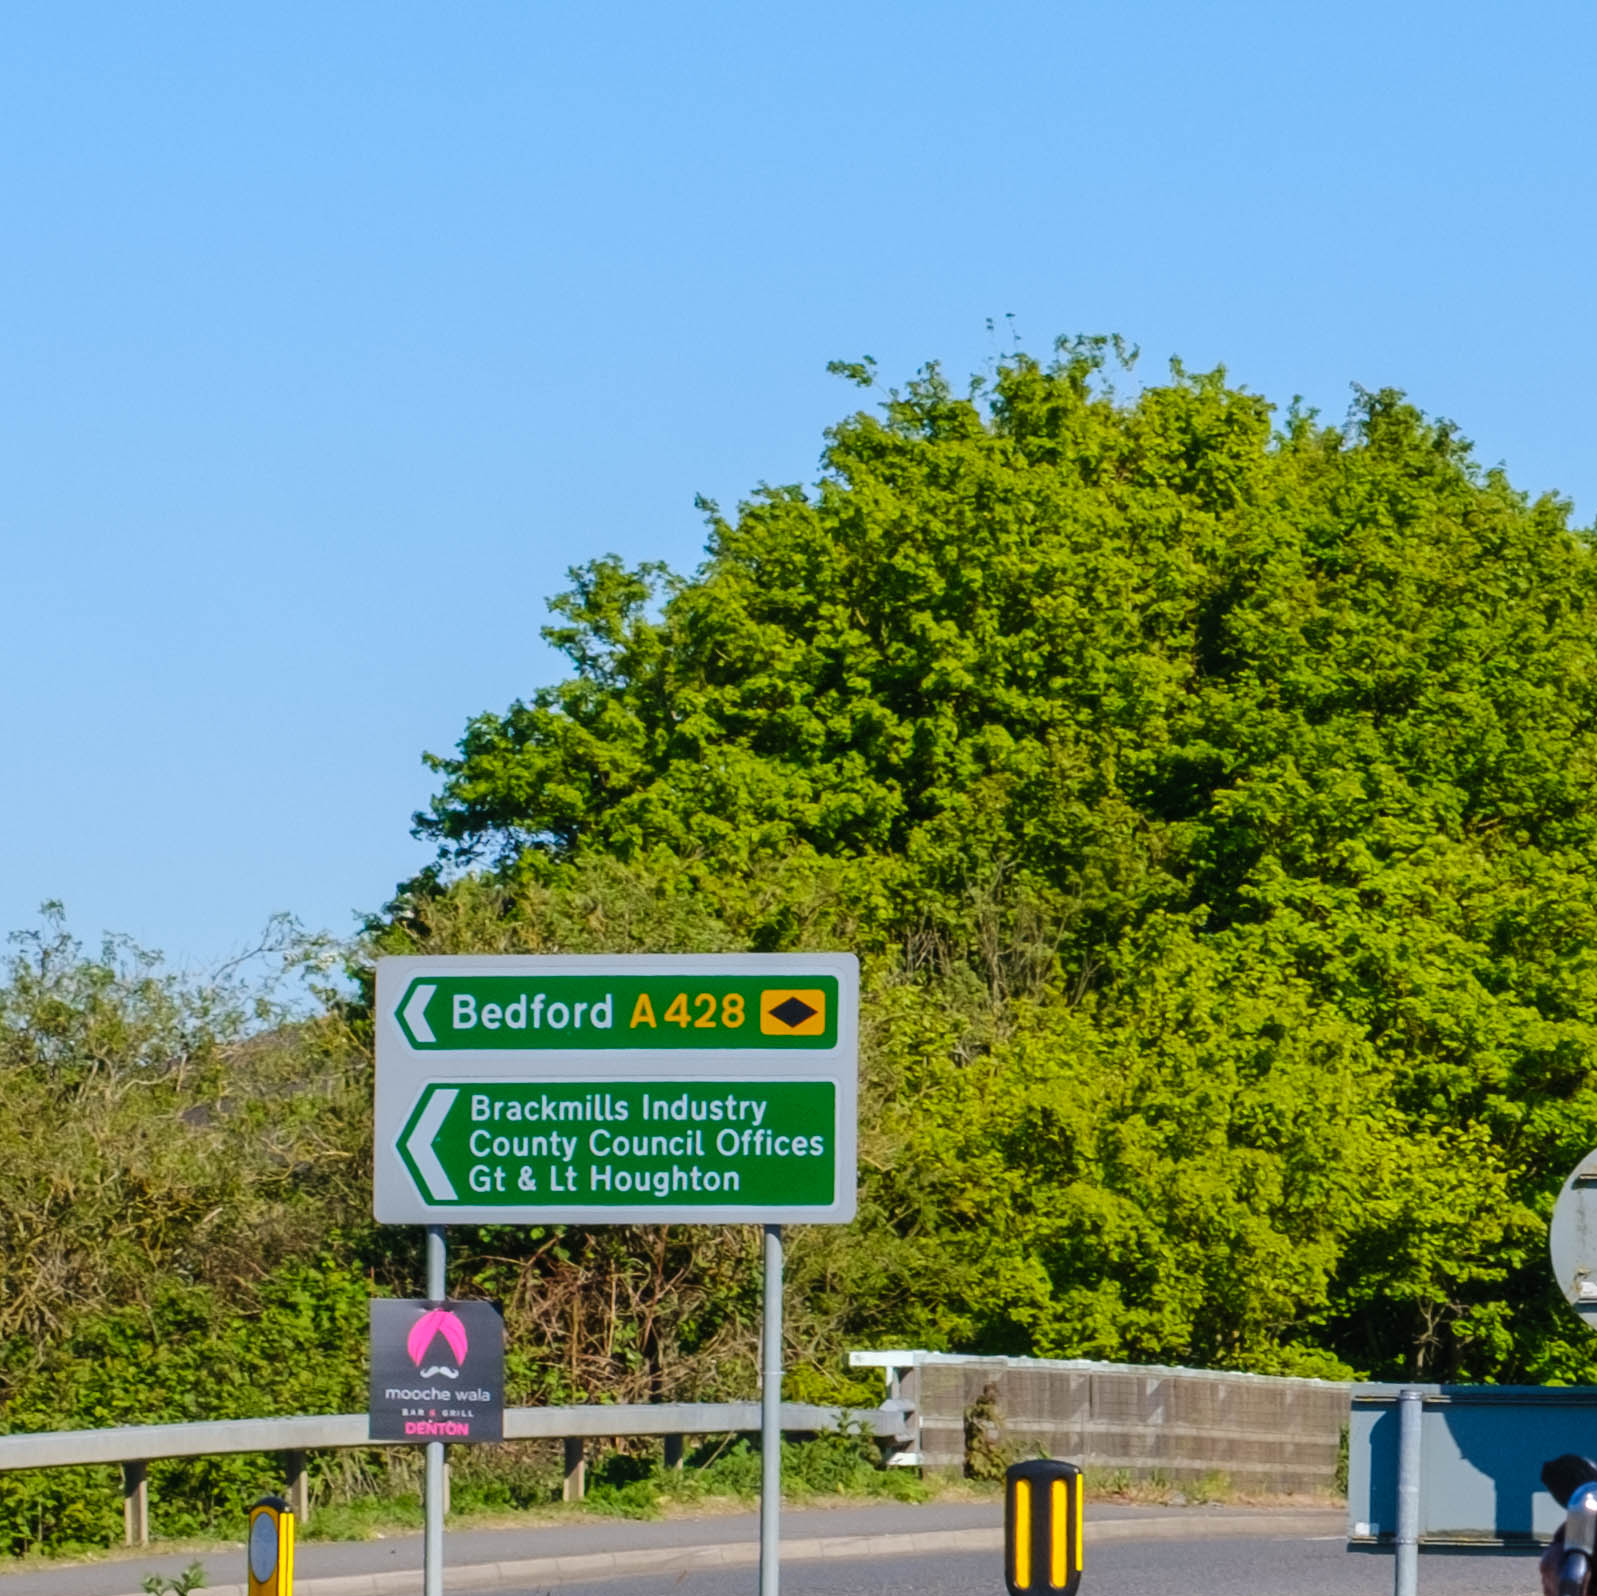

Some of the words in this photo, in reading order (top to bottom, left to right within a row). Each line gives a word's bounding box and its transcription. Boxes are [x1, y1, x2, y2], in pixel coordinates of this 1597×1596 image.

[451, 993, 613, 1030] Bedford
[629, 993, 746, 1029] A428
[470, 1094, 629, 1121] Brackmills
[642, 1094, 767, 1126] Industry
[468, 1130, 577, 1161] County
[588, 1129, 705, 1157] Council
[715, 1128, 825, 1157] Offices
[468, 1165, 506, 1192] Gt
[517, 1165, 537, 1192] &
[550, 1165, 578, 1192] Lt
[589, 1165, 740, 1197] Houghton
[385, 1387, 451, 1401] mooche
[455, 1388, 491, 1401] wala
[401, 1408, 425, 1417] BAR
[441, 1409, 475, 1418] GRILL
[404, 1421, 470, 1436] DENTON
